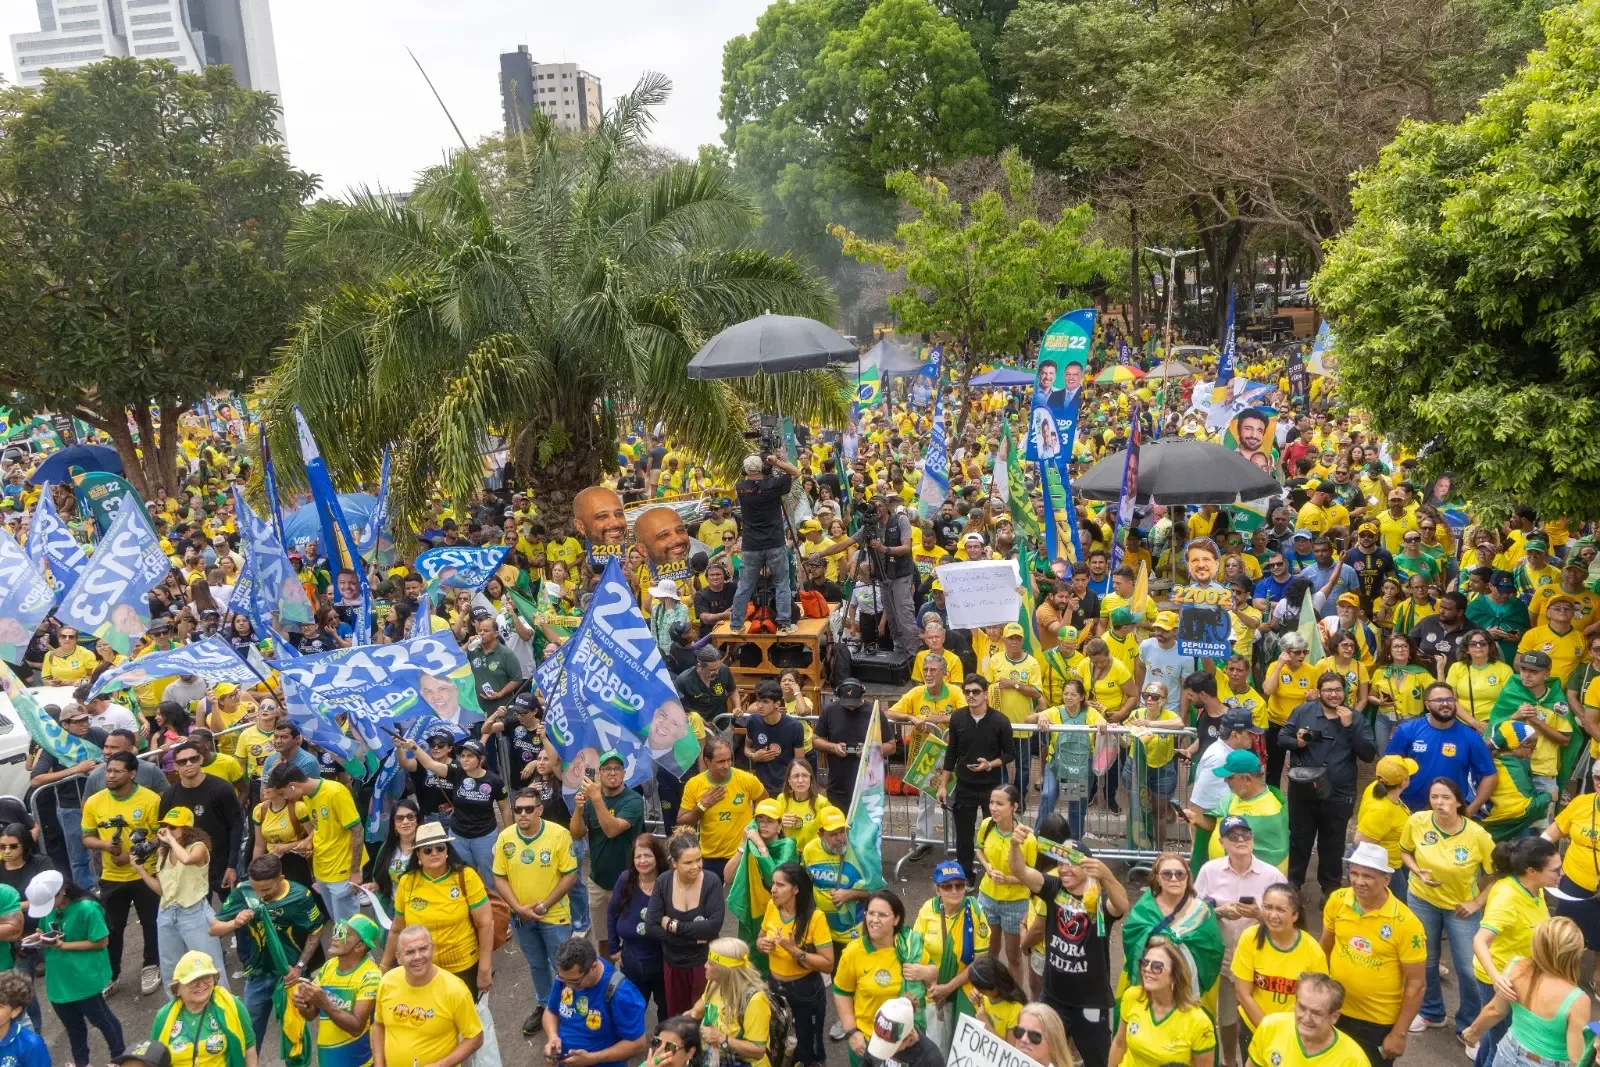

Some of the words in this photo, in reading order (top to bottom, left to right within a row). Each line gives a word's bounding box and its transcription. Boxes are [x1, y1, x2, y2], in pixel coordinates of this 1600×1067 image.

[1069, 335, 1087, 349] 22
[106, 481, 120, 492] 22
[592, 544, 622, 556] 2201
[656, 560, 688, 576] 2201
[1170, 586, 1233, 610] 22002
[1181, 641, 1226, 650] DEPUTADO
[1183, 647, 1225, 657] ESTADUAL
[614, 647, 649, 680] ESTADUAL
[719, 811, 731, 821] 22
[1050, 935, 1086, 957] FORA
[1050, 952, 1088, 973] LULA!
[960, 1022, 999, 1063] FORA
